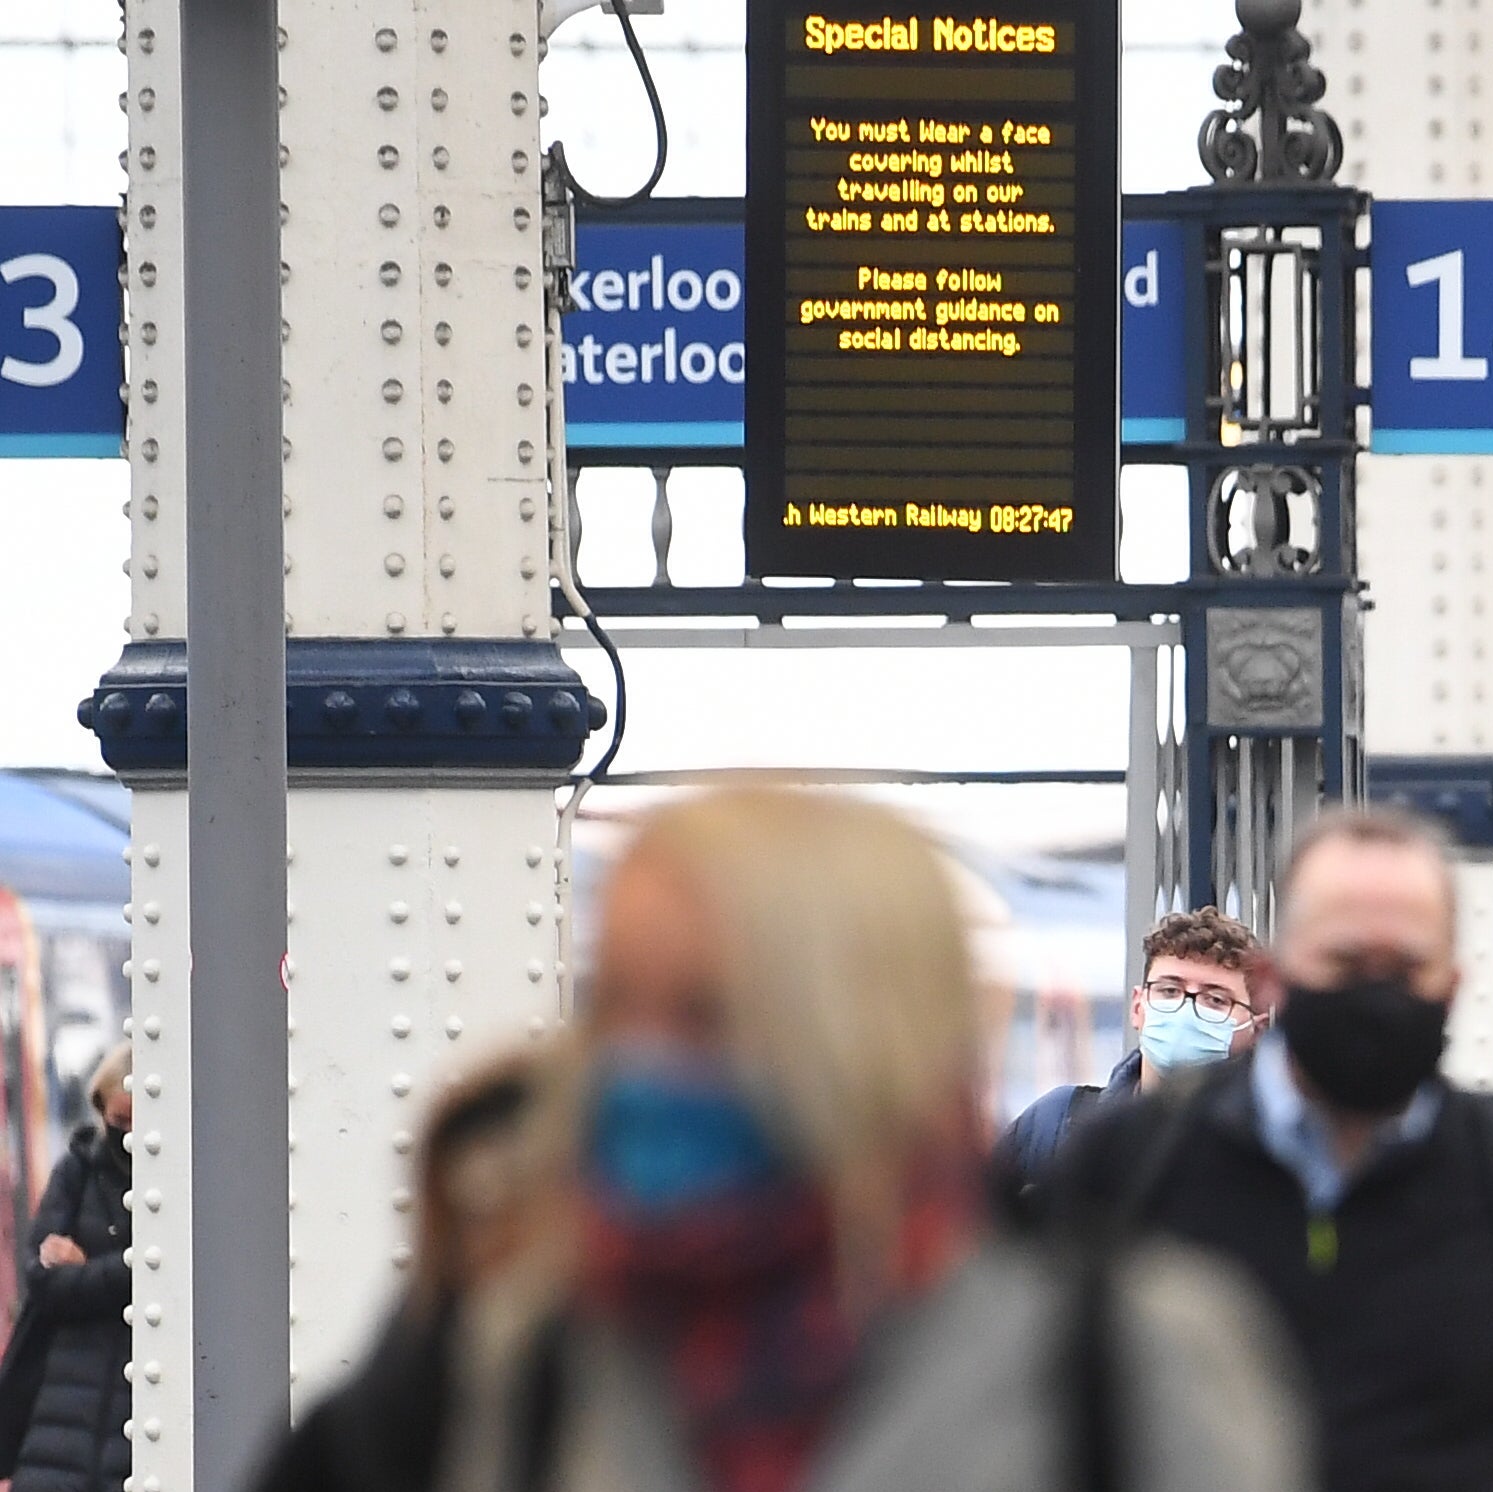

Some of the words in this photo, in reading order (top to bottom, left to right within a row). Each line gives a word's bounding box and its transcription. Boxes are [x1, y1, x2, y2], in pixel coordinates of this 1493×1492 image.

[805, 15, 919, 55] Special
[933, 16, 1055, 53] Notices
[810, 117, 851, 142] You
[858, 118, 911, 143] must
[979, 124, 993, 144] a
[1001, 119, 1051, 145] face
[849, 148, 943, 178] covering
[950, 149, 1014, 174] whilst
[837, 173, 945, 207] travelling
[952, 183, 978, 204] on
[986, 183, 1024, 204] our
[805, 207, 872, 232] trains
[880, 208, 919, 232] and
[926, 208, 951, 233] at
[959, 208, 1055, 233] stations.
[568, 254, 741, 312] kerloo
[858, 266, 927, 291] Please
[935, 268, 1002, 293] follow
[800, 296, 927, 324] government
[935, 296, 1026, 326] guidance
[1034, 303, 1060, 323] on
[561, 327, 746, 384] aterloo
[838, 326, 901, 351] social
[908, 326, 1021, 357] distancing.
[809, 502, 898, 527] Western
[905, 502, 982, 533] Railway
[989, 504, 1073, 533] 08:27:47
